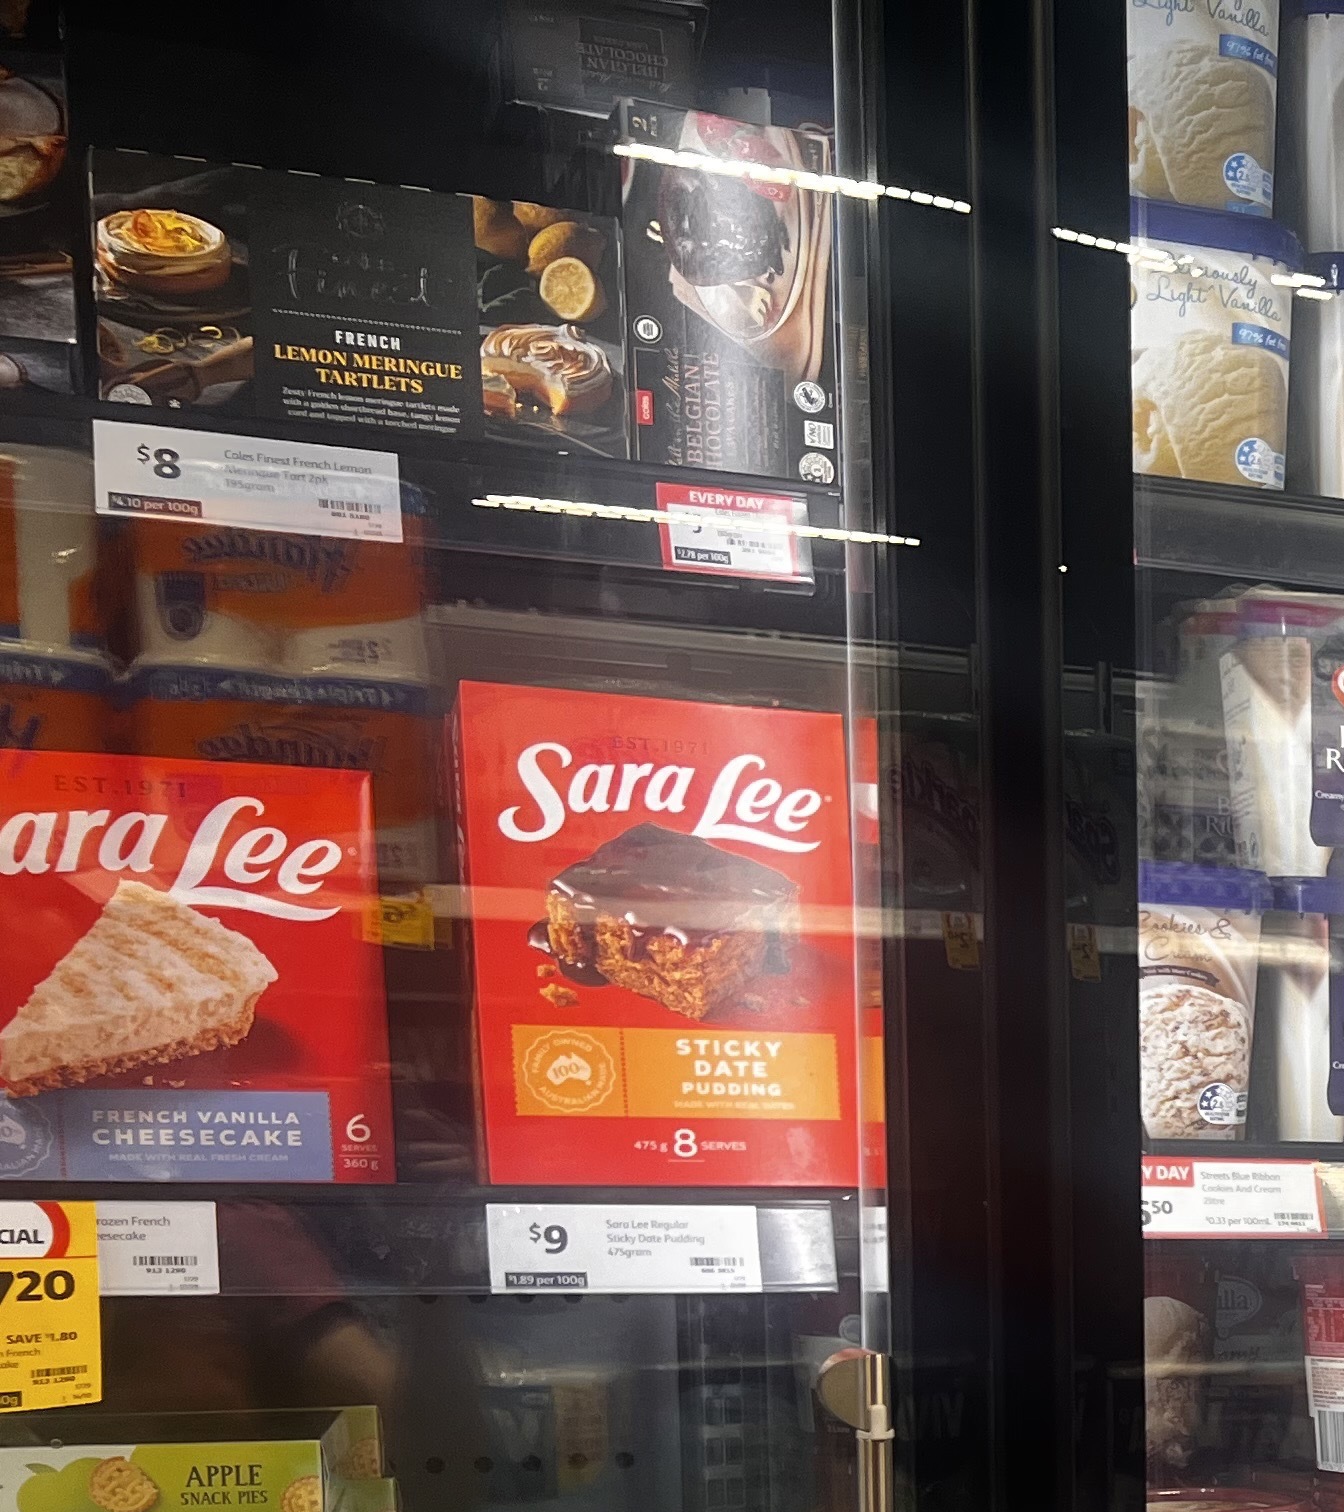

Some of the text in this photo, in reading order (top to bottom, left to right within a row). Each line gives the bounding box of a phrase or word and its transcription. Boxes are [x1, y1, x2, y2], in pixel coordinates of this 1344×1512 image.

[334, 330, 402, 351] FRENCH
[273, 344, 463, 380] LEMON MERINGUE
[315, 367, 425, 394] TARTLETS
[224, 449, 372, 475] Coles Finest French Lemon
[498, 741, 822, 853] Sara Lee
[676, 1039, 782, 1058] STICKY
[694, 1061, 767, 1078] DATE
[682, 1082, 782, 1097] PUDDING
[92, 1108, 301, 1127] FRENCH VANILLA
[92, 1126, 303, 1149] CHEESECAKE
[673, 1128, 747, 1158] 8 SERVES
[606, 1219, 689, 1232] Sara Lee Regular
[606, 1233, 705, 1247] Sticky Date Pudding
[537, 1275, 555, 1288] per
[557, 1274, 585, 1289] 100g
[185, 1464, 263, 1489] APPLE
[180, 1490, 269, 1506] SNACK PIES
